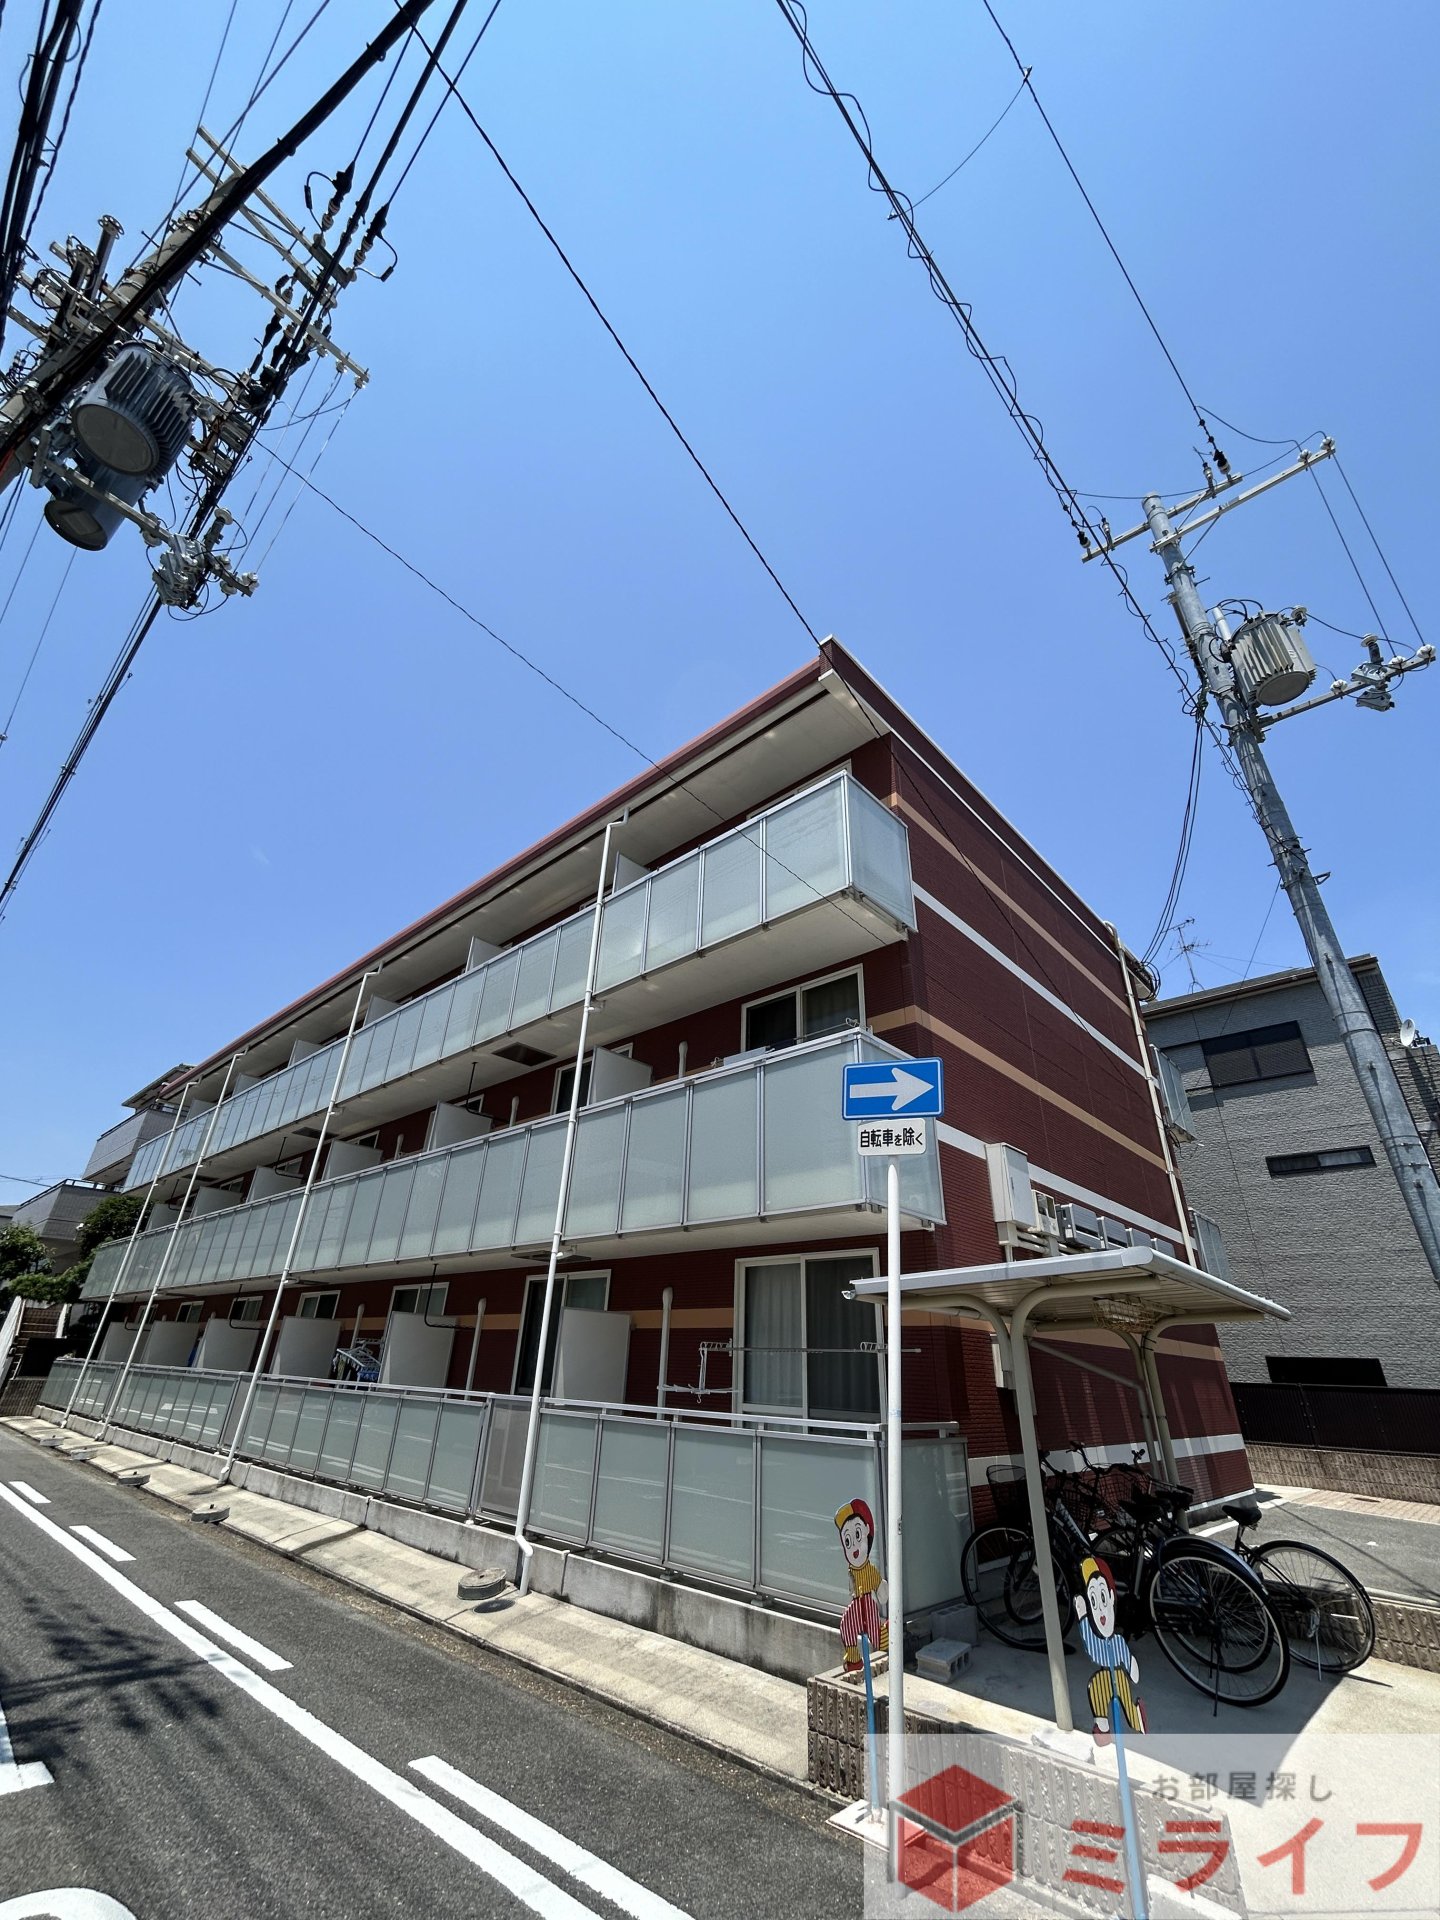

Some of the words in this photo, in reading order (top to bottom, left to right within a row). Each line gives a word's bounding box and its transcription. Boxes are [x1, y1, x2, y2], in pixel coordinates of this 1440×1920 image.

[860, 1127, 923, 1148] 自転車を除く
